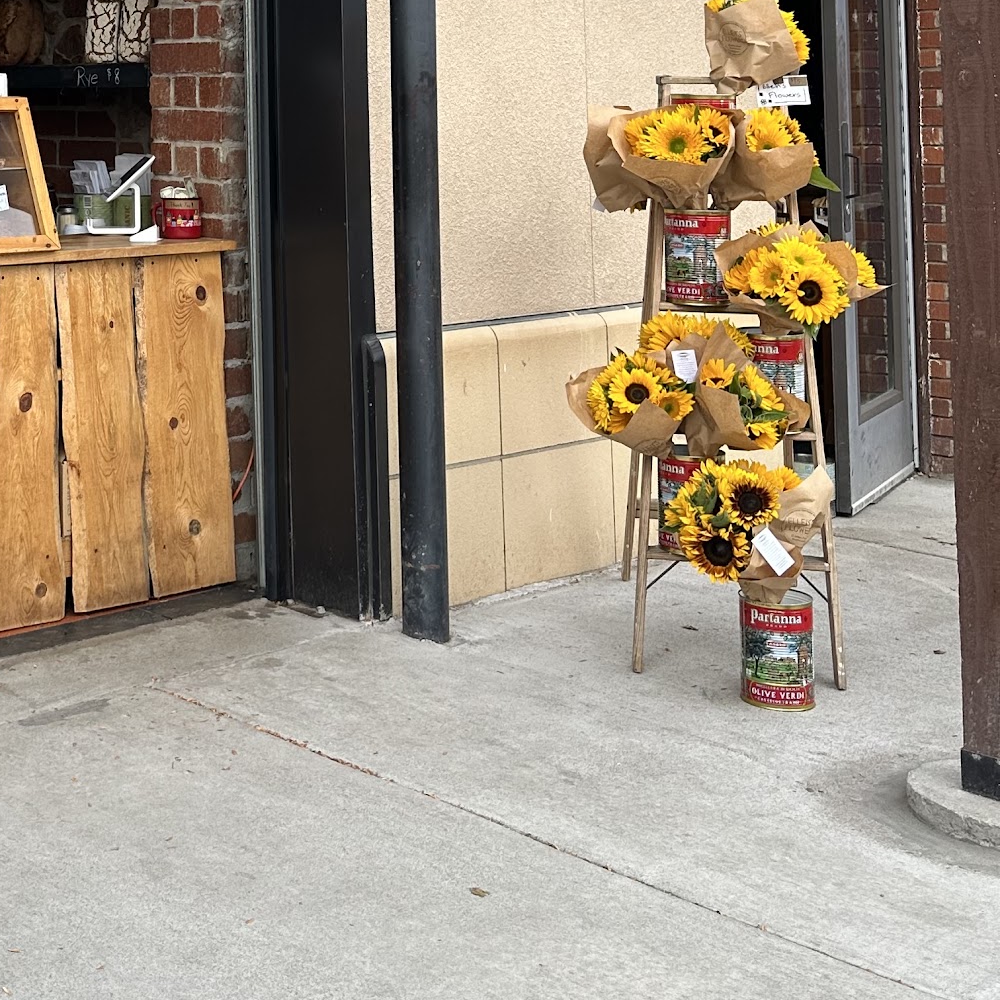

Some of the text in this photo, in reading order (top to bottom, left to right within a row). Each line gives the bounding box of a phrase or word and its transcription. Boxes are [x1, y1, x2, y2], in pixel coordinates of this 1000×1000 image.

[73, 66, 121, 87] Rye $8
[677, 286, 701, 295] VERDI
[750, 608, 802, 625] Partanna
[751, 687, 777, 698] OLIVE
[780, 691, 805, 700] VERDI
